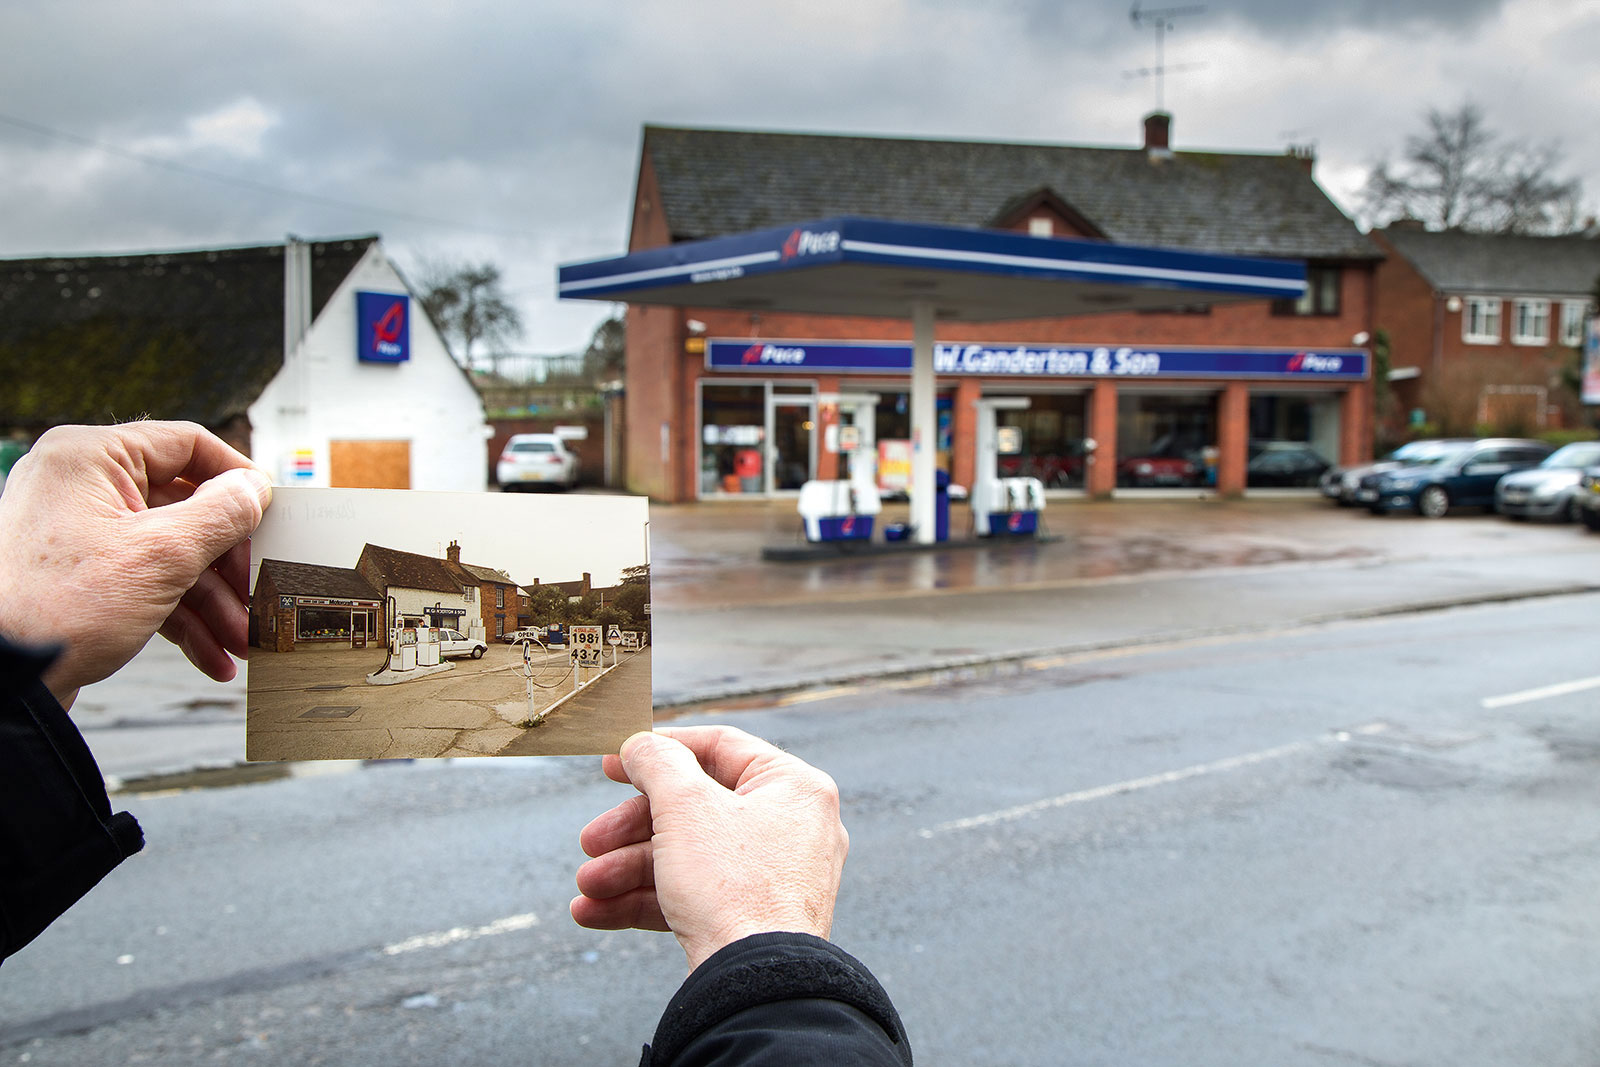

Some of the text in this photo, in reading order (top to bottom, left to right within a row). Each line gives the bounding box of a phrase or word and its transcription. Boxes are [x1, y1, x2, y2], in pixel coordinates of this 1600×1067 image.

[798, 229, 841, 257] Pace
[762, 345, 806, 365] Pace
[1090, 347, 1112, 375] &
[1115, 348, 1160, 376] Son
[1301, 354, 1343, 373] Pace
